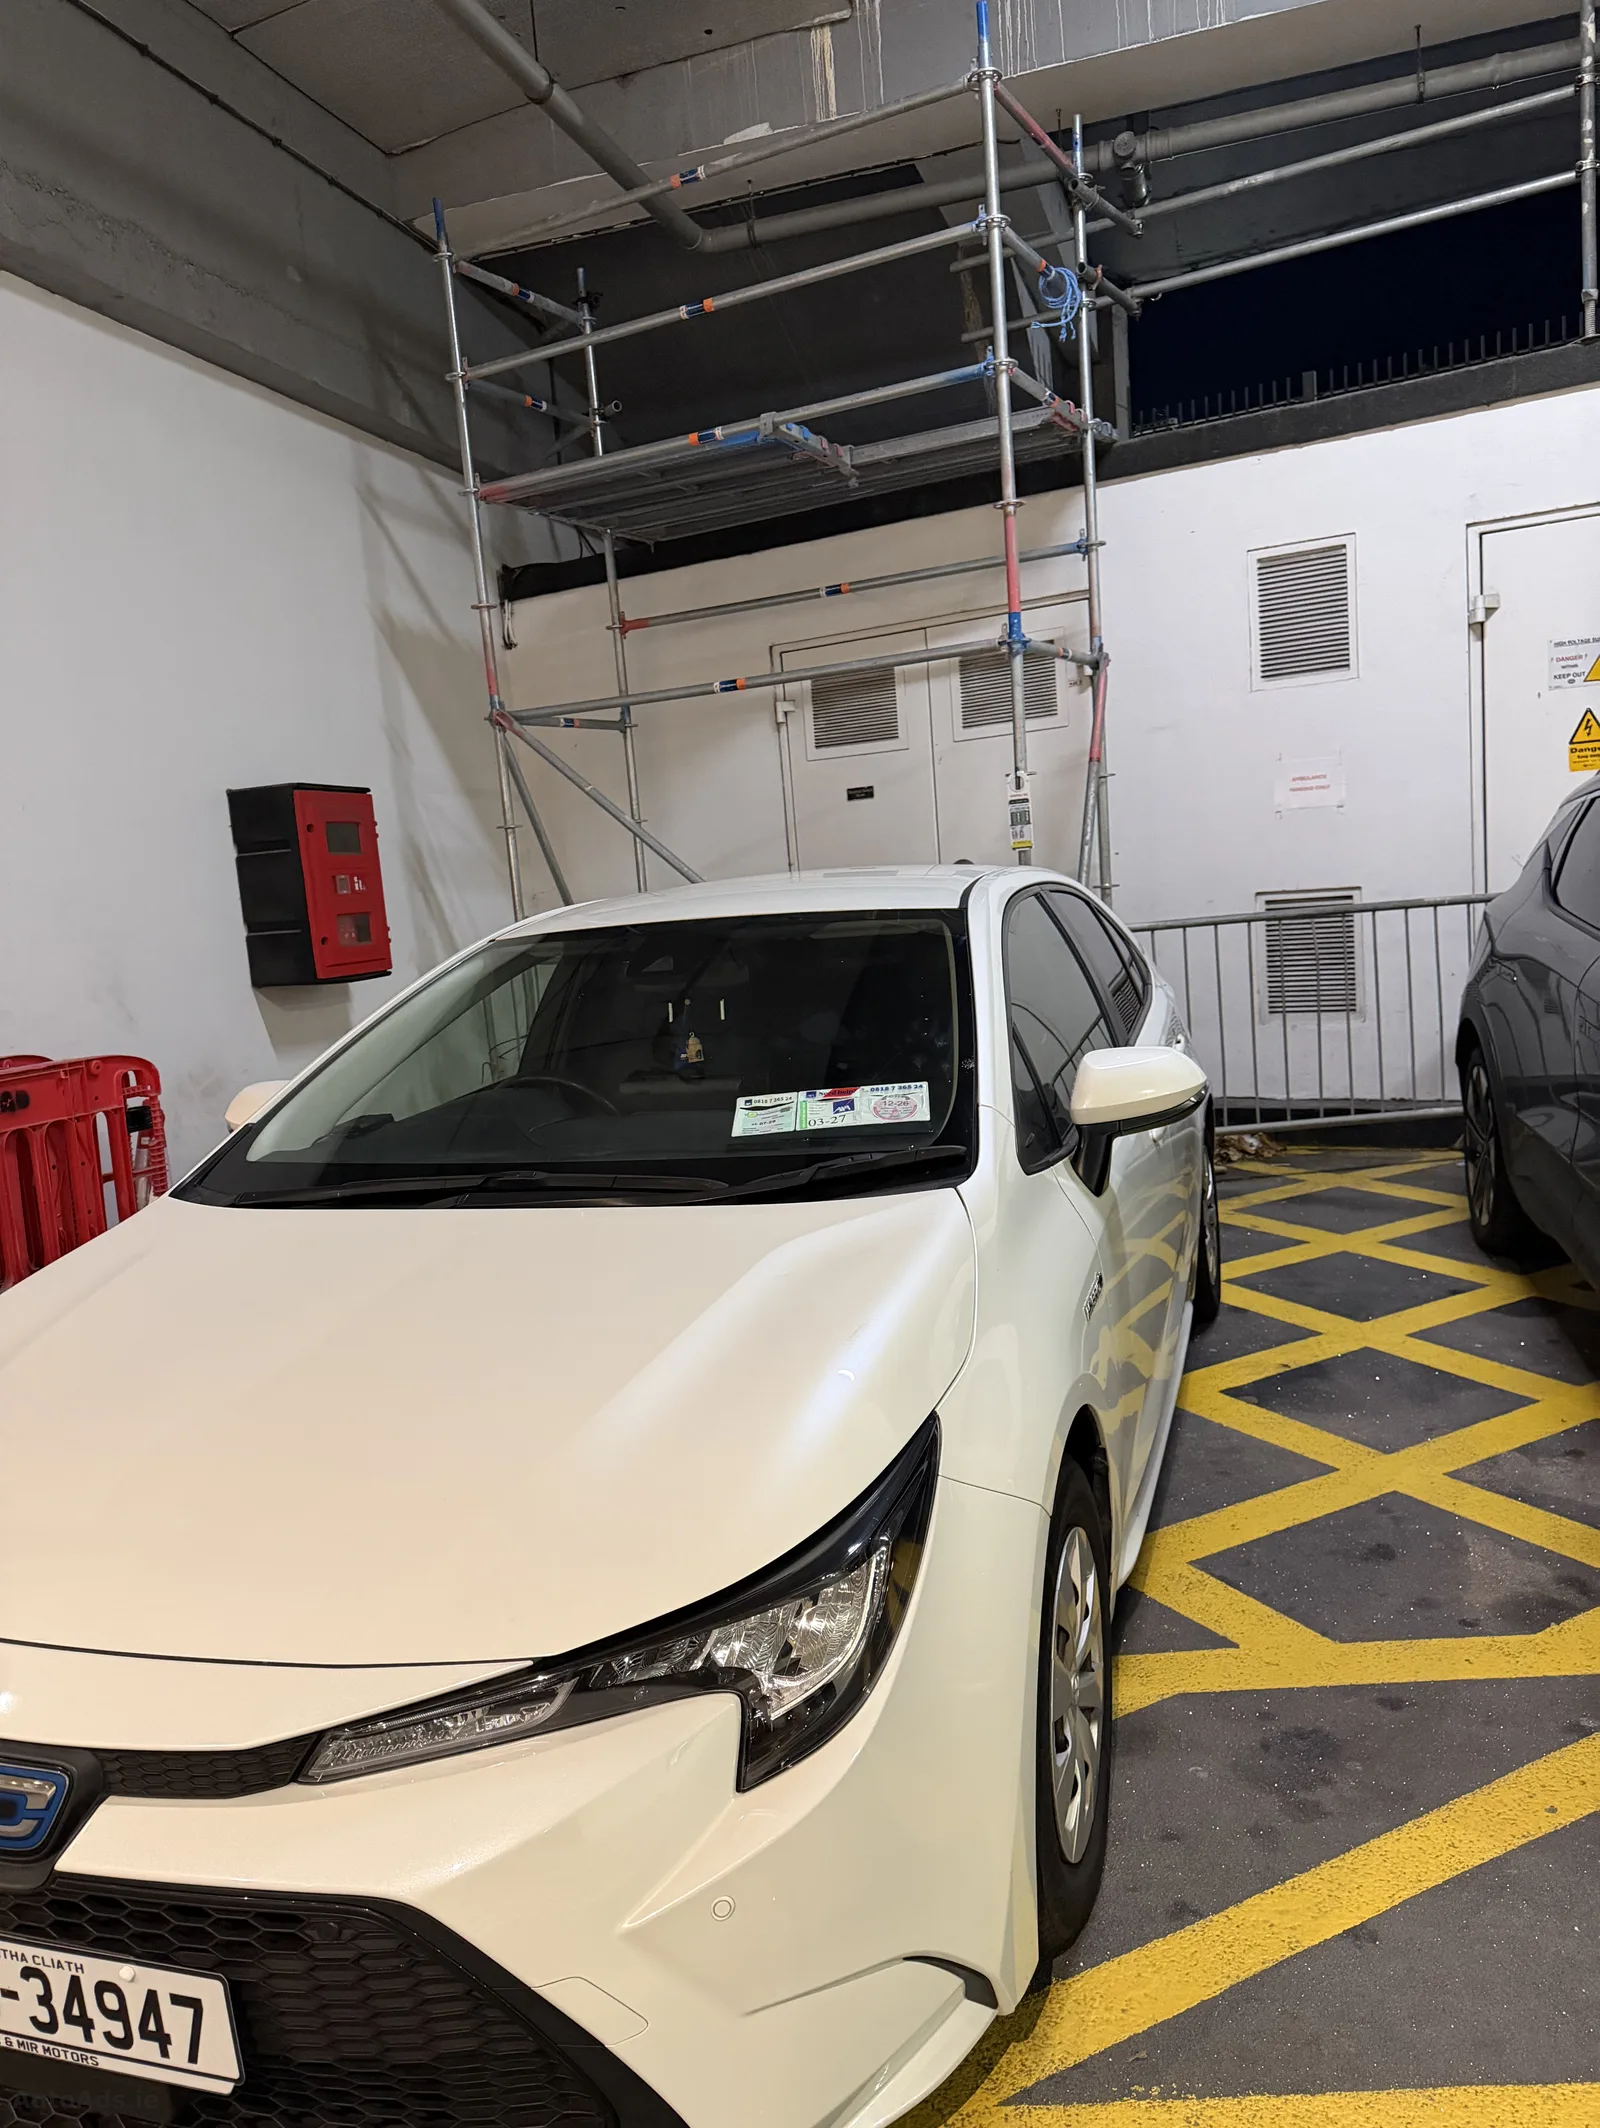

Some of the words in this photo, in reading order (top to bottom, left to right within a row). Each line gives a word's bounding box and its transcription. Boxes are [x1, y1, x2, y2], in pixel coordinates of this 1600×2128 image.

[1555, 654, 1584, 662] DANGER
[1553, 672, 1571, 680] KEEP
[808, 1114, 846, 1127] 03-27
[0, 1948, 28, 1963] THA
[32, 1954, 85, 1974] CLIATH
[0, 1965, 204, 2065] -34947
[4, 2036, 14, 2047] &
[16, 2039, 39, 2054] MIR
[41, 2044, 100, 2067] MOTORS
